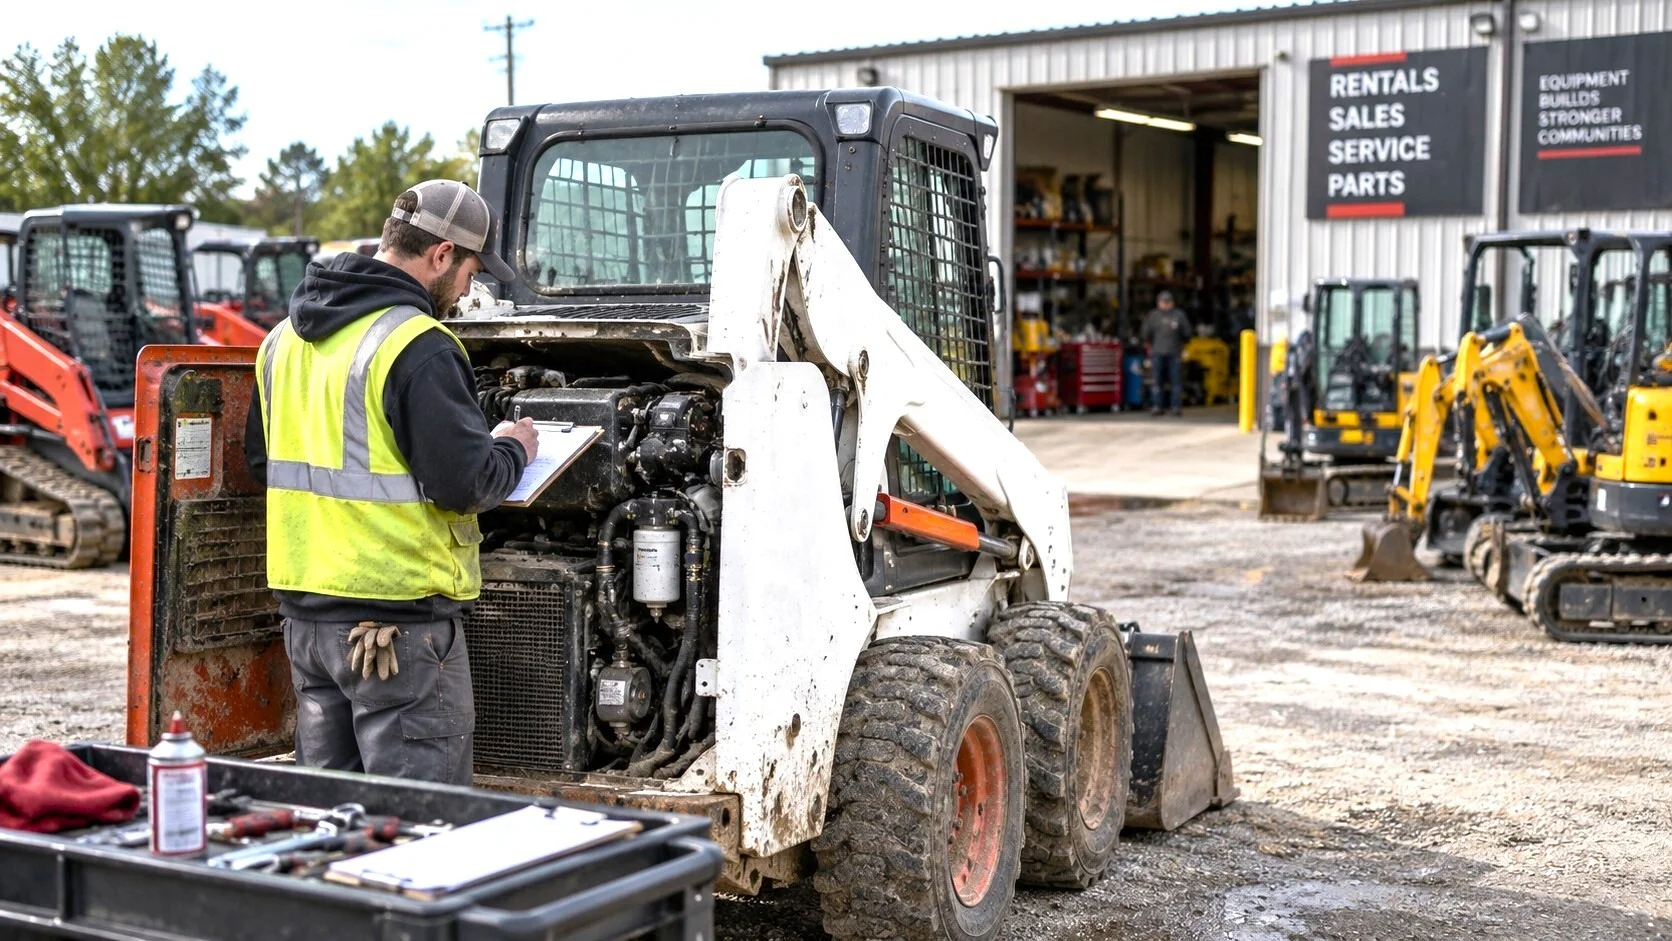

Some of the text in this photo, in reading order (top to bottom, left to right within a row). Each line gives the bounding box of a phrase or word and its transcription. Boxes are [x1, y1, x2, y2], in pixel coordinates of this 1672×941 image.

[1330, 67, 1440, 98] RENTALS
[1539, 69, 1630, 91] EQUIPMENT
[1329, 102, 1405, 131] SALES
[1538, 107, 1623, 127] STRONGER
[1537, 124, 1643, 145] COMMUNITIES
[1328, 135, 1431, 164] SERVICE
[1328, 170, 1405, 197] PARTS
